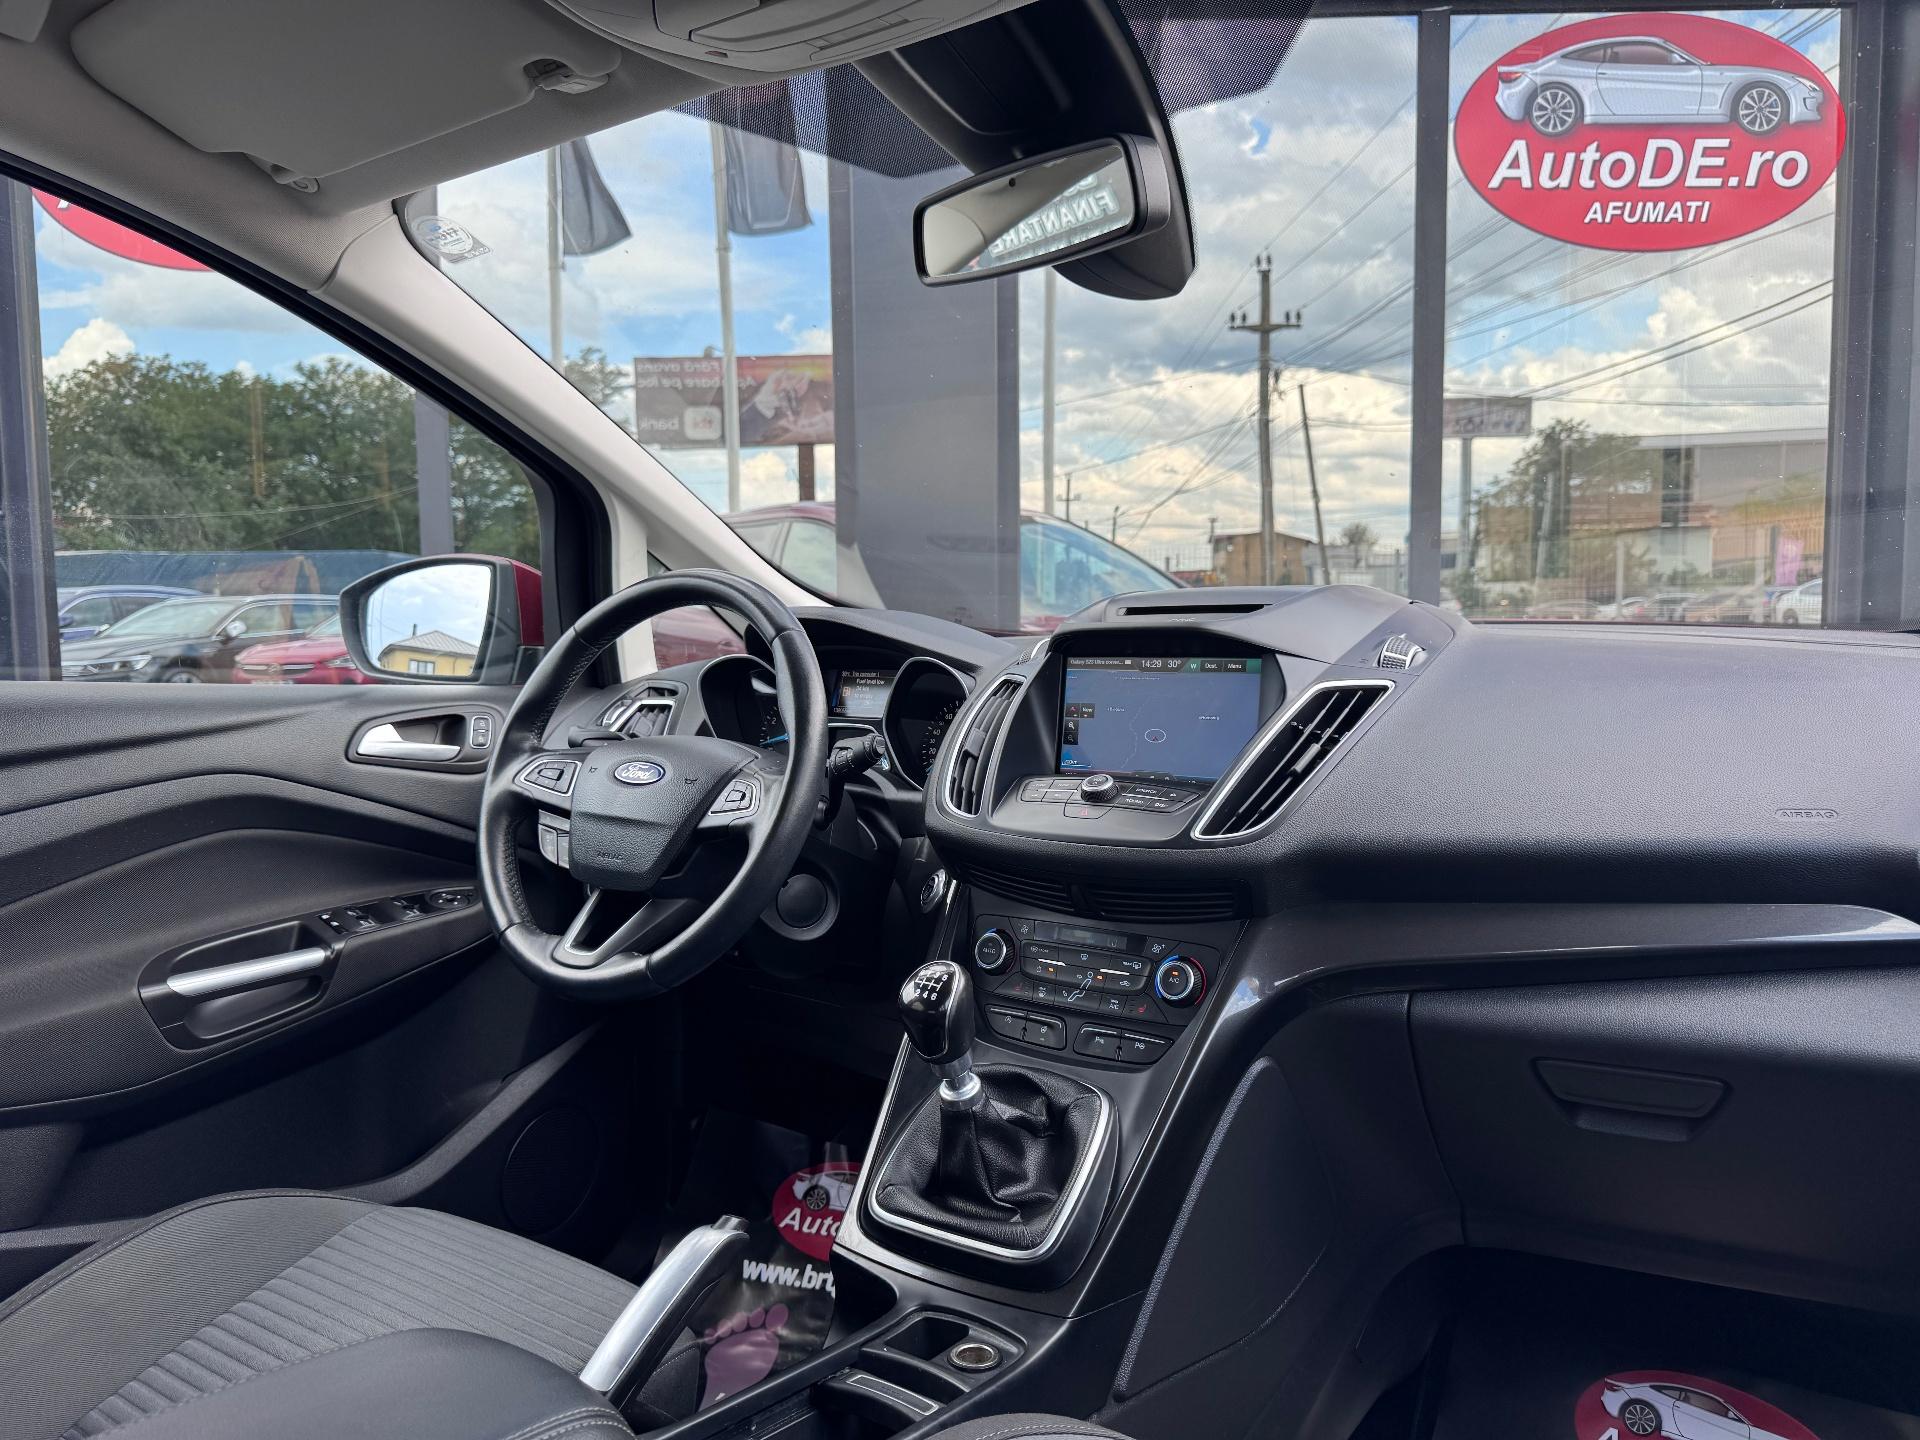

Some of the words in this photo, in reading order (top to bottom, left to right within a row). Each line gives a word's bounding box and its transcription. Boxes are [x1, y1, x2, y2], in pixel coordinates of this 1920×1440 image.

[1488, 138, 1810, 190] AutoDE.ro
[1583, 201, 1711, 224] AFUMATI
[1142, 660, 1161, 668] 14:29
[1780, 811, 1835, 819] AIRBAG
